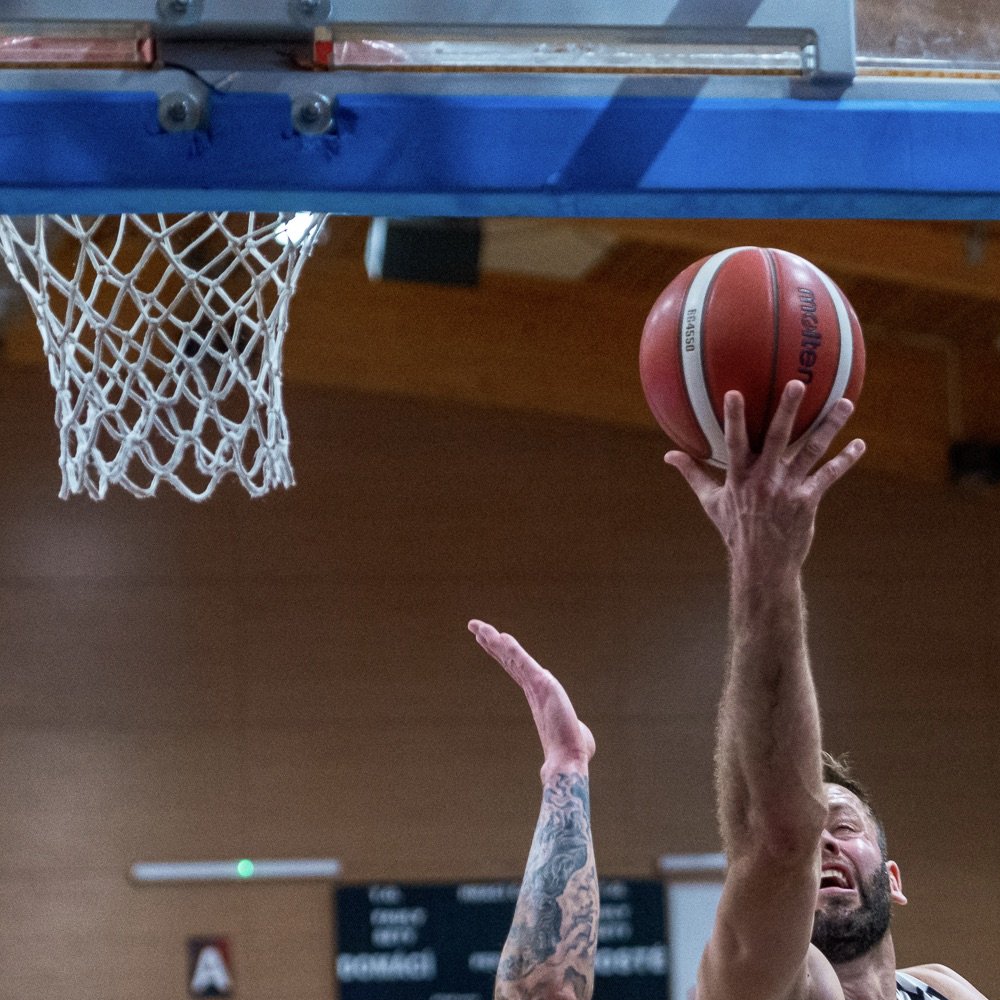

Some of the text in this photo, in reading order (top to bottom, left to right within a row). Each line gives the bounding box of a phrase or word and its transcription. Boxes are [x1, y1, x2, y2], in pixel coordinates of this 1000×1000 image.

[685, 308, 697, 352] BG4550
[798, 287, 821, 385] molten
[192, 944, 231, 993] A
